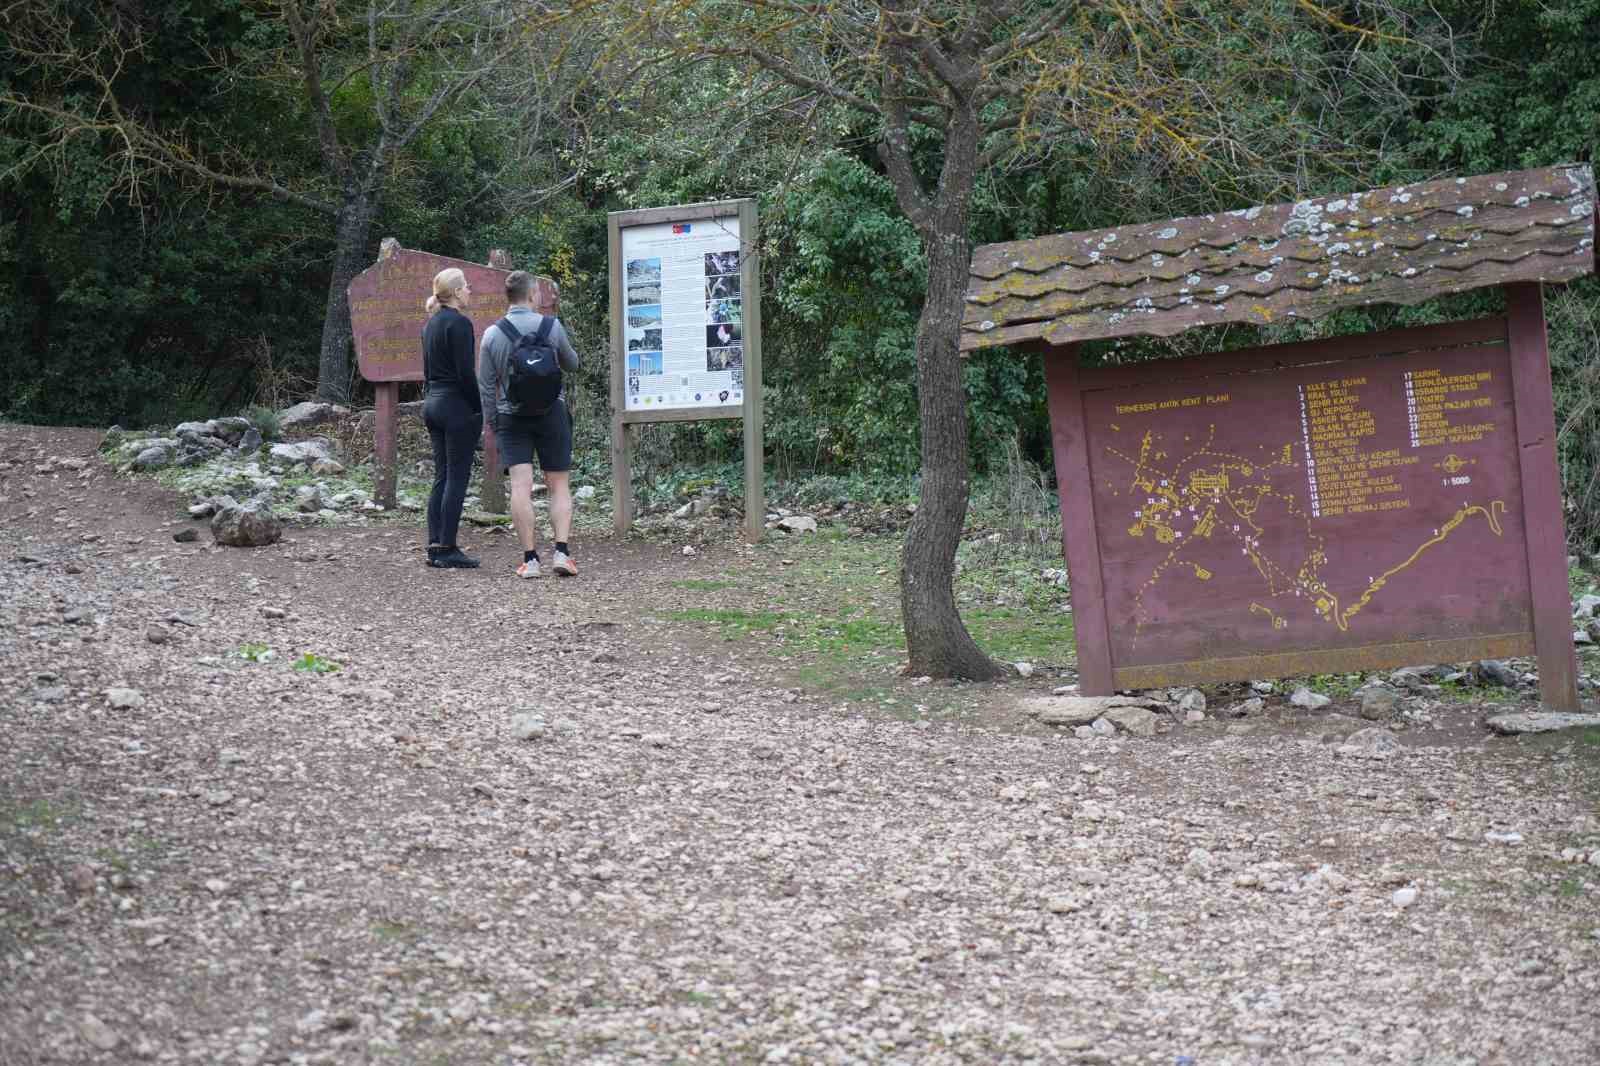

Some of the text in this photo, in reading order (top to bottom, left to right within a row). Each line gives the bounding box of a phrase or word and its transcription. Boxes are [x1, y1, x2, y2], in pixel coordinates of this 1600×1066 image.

[1404, 371, 1412, 380] 17
[1405, 380, 1413, 388] 18
[1406, 389, 1414, 397] 19
[1407, 397, 1416, 405] 20
[1407, 406, 1416, 414] 21
[1408, 414, 1417, 422] 22
[1409, 422, 1418, 431] 23
[1410, 431, 1419, 439] 24
[1411, 439, 1420, 447] 25
[1307, 468, 1314, 476] 11
[1308, 476, 1316, 484] 12
[1451, 476, 1471, 486] 5000
[1310, 484, 1317, 492] 13
[1312, 501, 1320, 509] 15
[1313, 509, 1320, 518] 16
